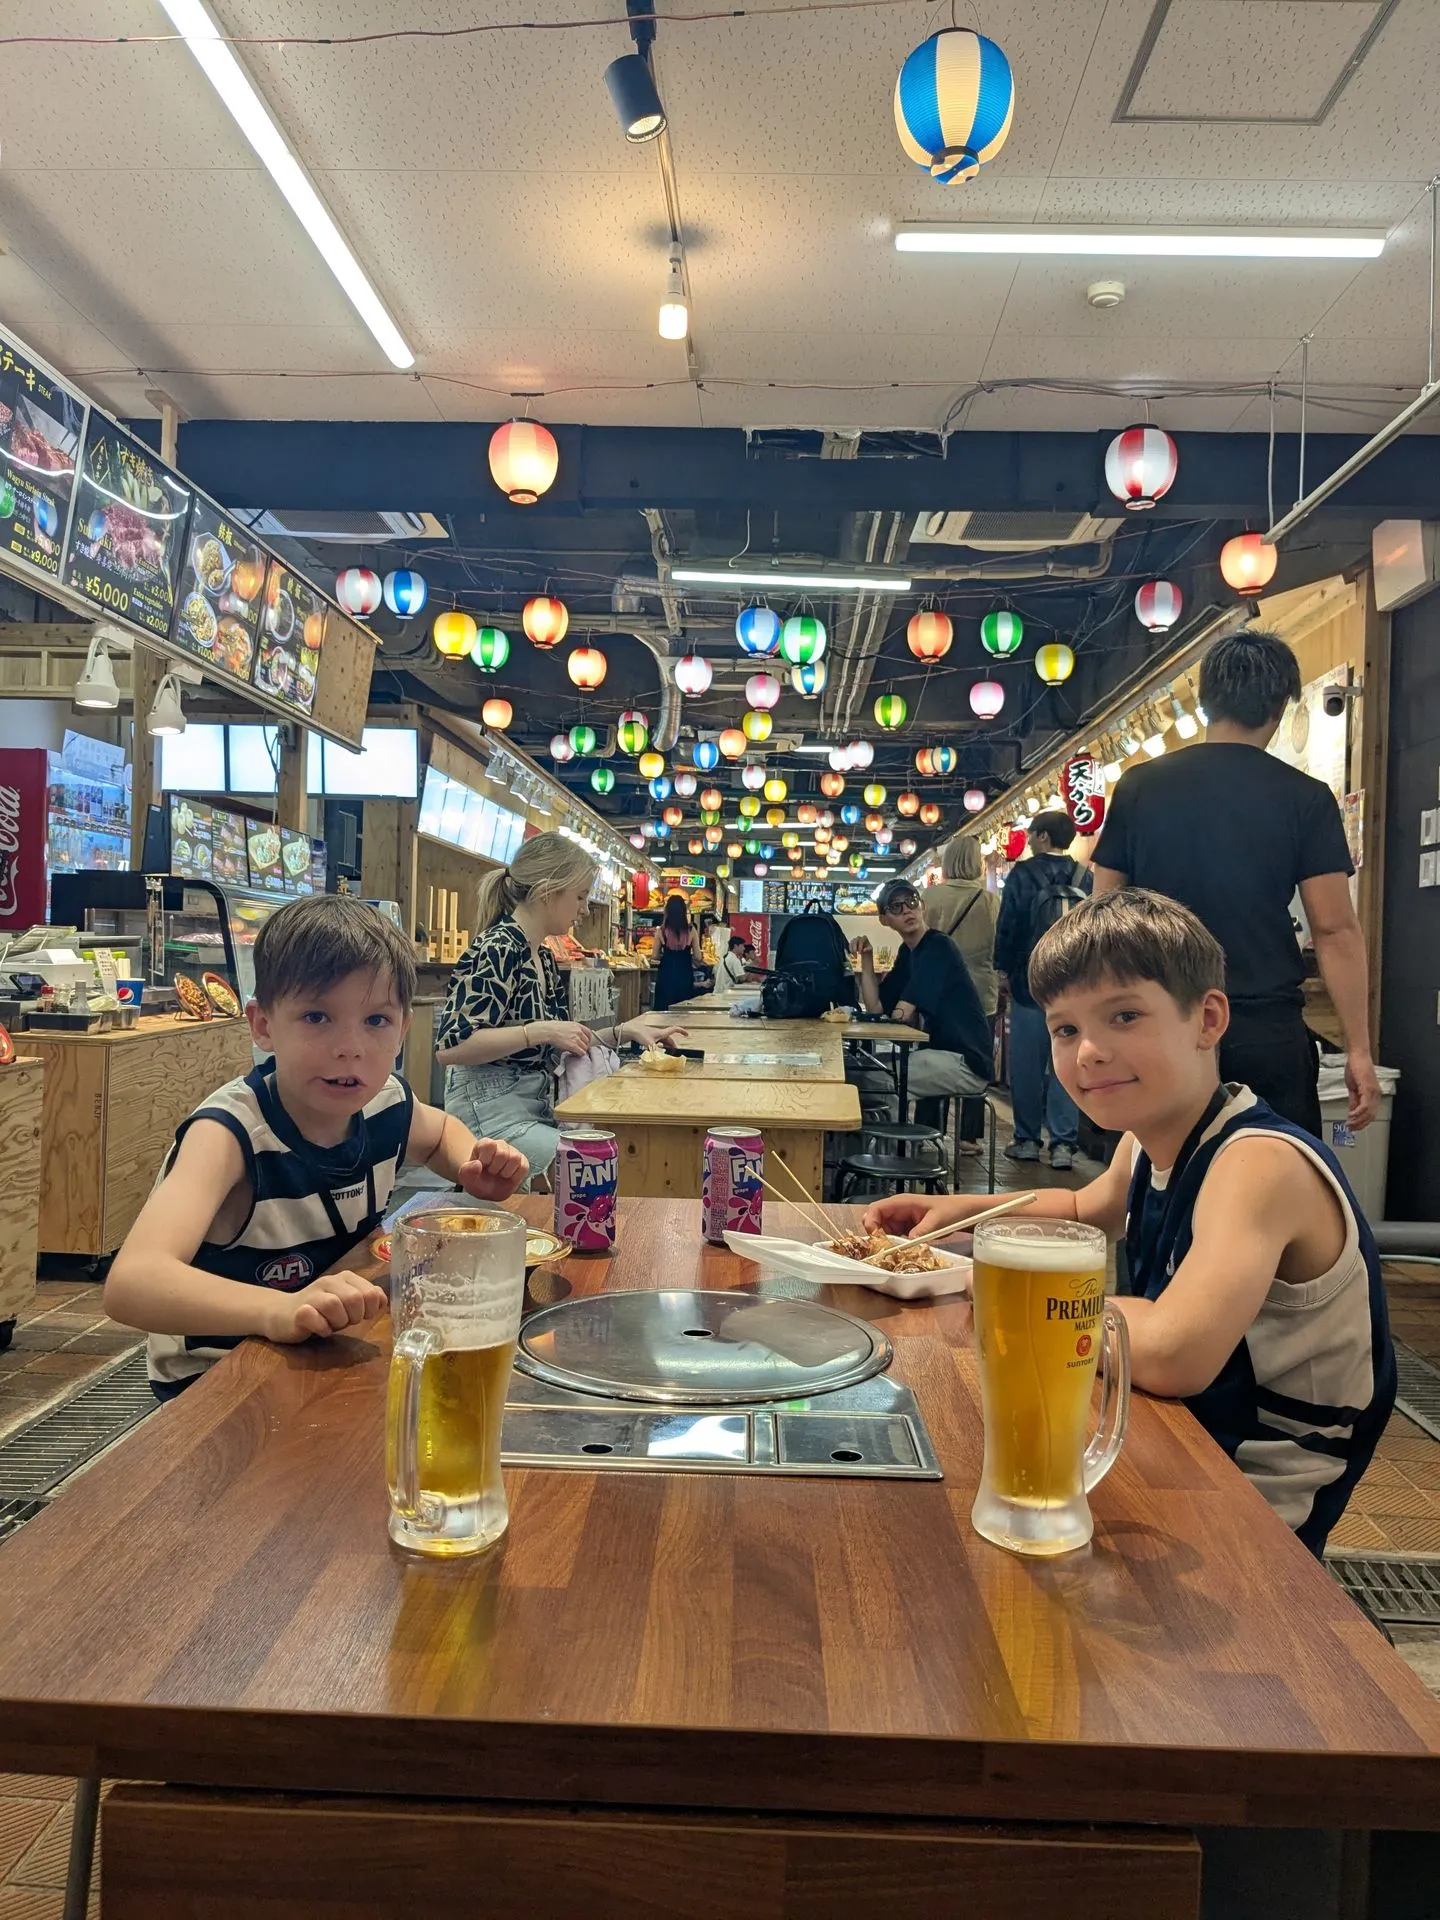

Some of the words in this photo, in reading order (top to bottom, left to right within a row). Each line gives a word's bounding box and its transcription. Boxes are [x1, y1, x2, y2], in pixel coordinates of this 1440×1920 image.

[31, 549, 58, 572] ¥9,000
[86, 575, 128, 611] ¥5,000
[146, 615, 168, 633] ¥2,000
[569, 1158, 617, 1187] FANT
[731, 1159, 763, 1183] FAN
[571, 1191, 587, 1200] grape
[262, 1260, 310, 1281] AFL
[1068, 1277, 1098, 1297] The
[1046, 1292, 1105, 1321] PREMIU
